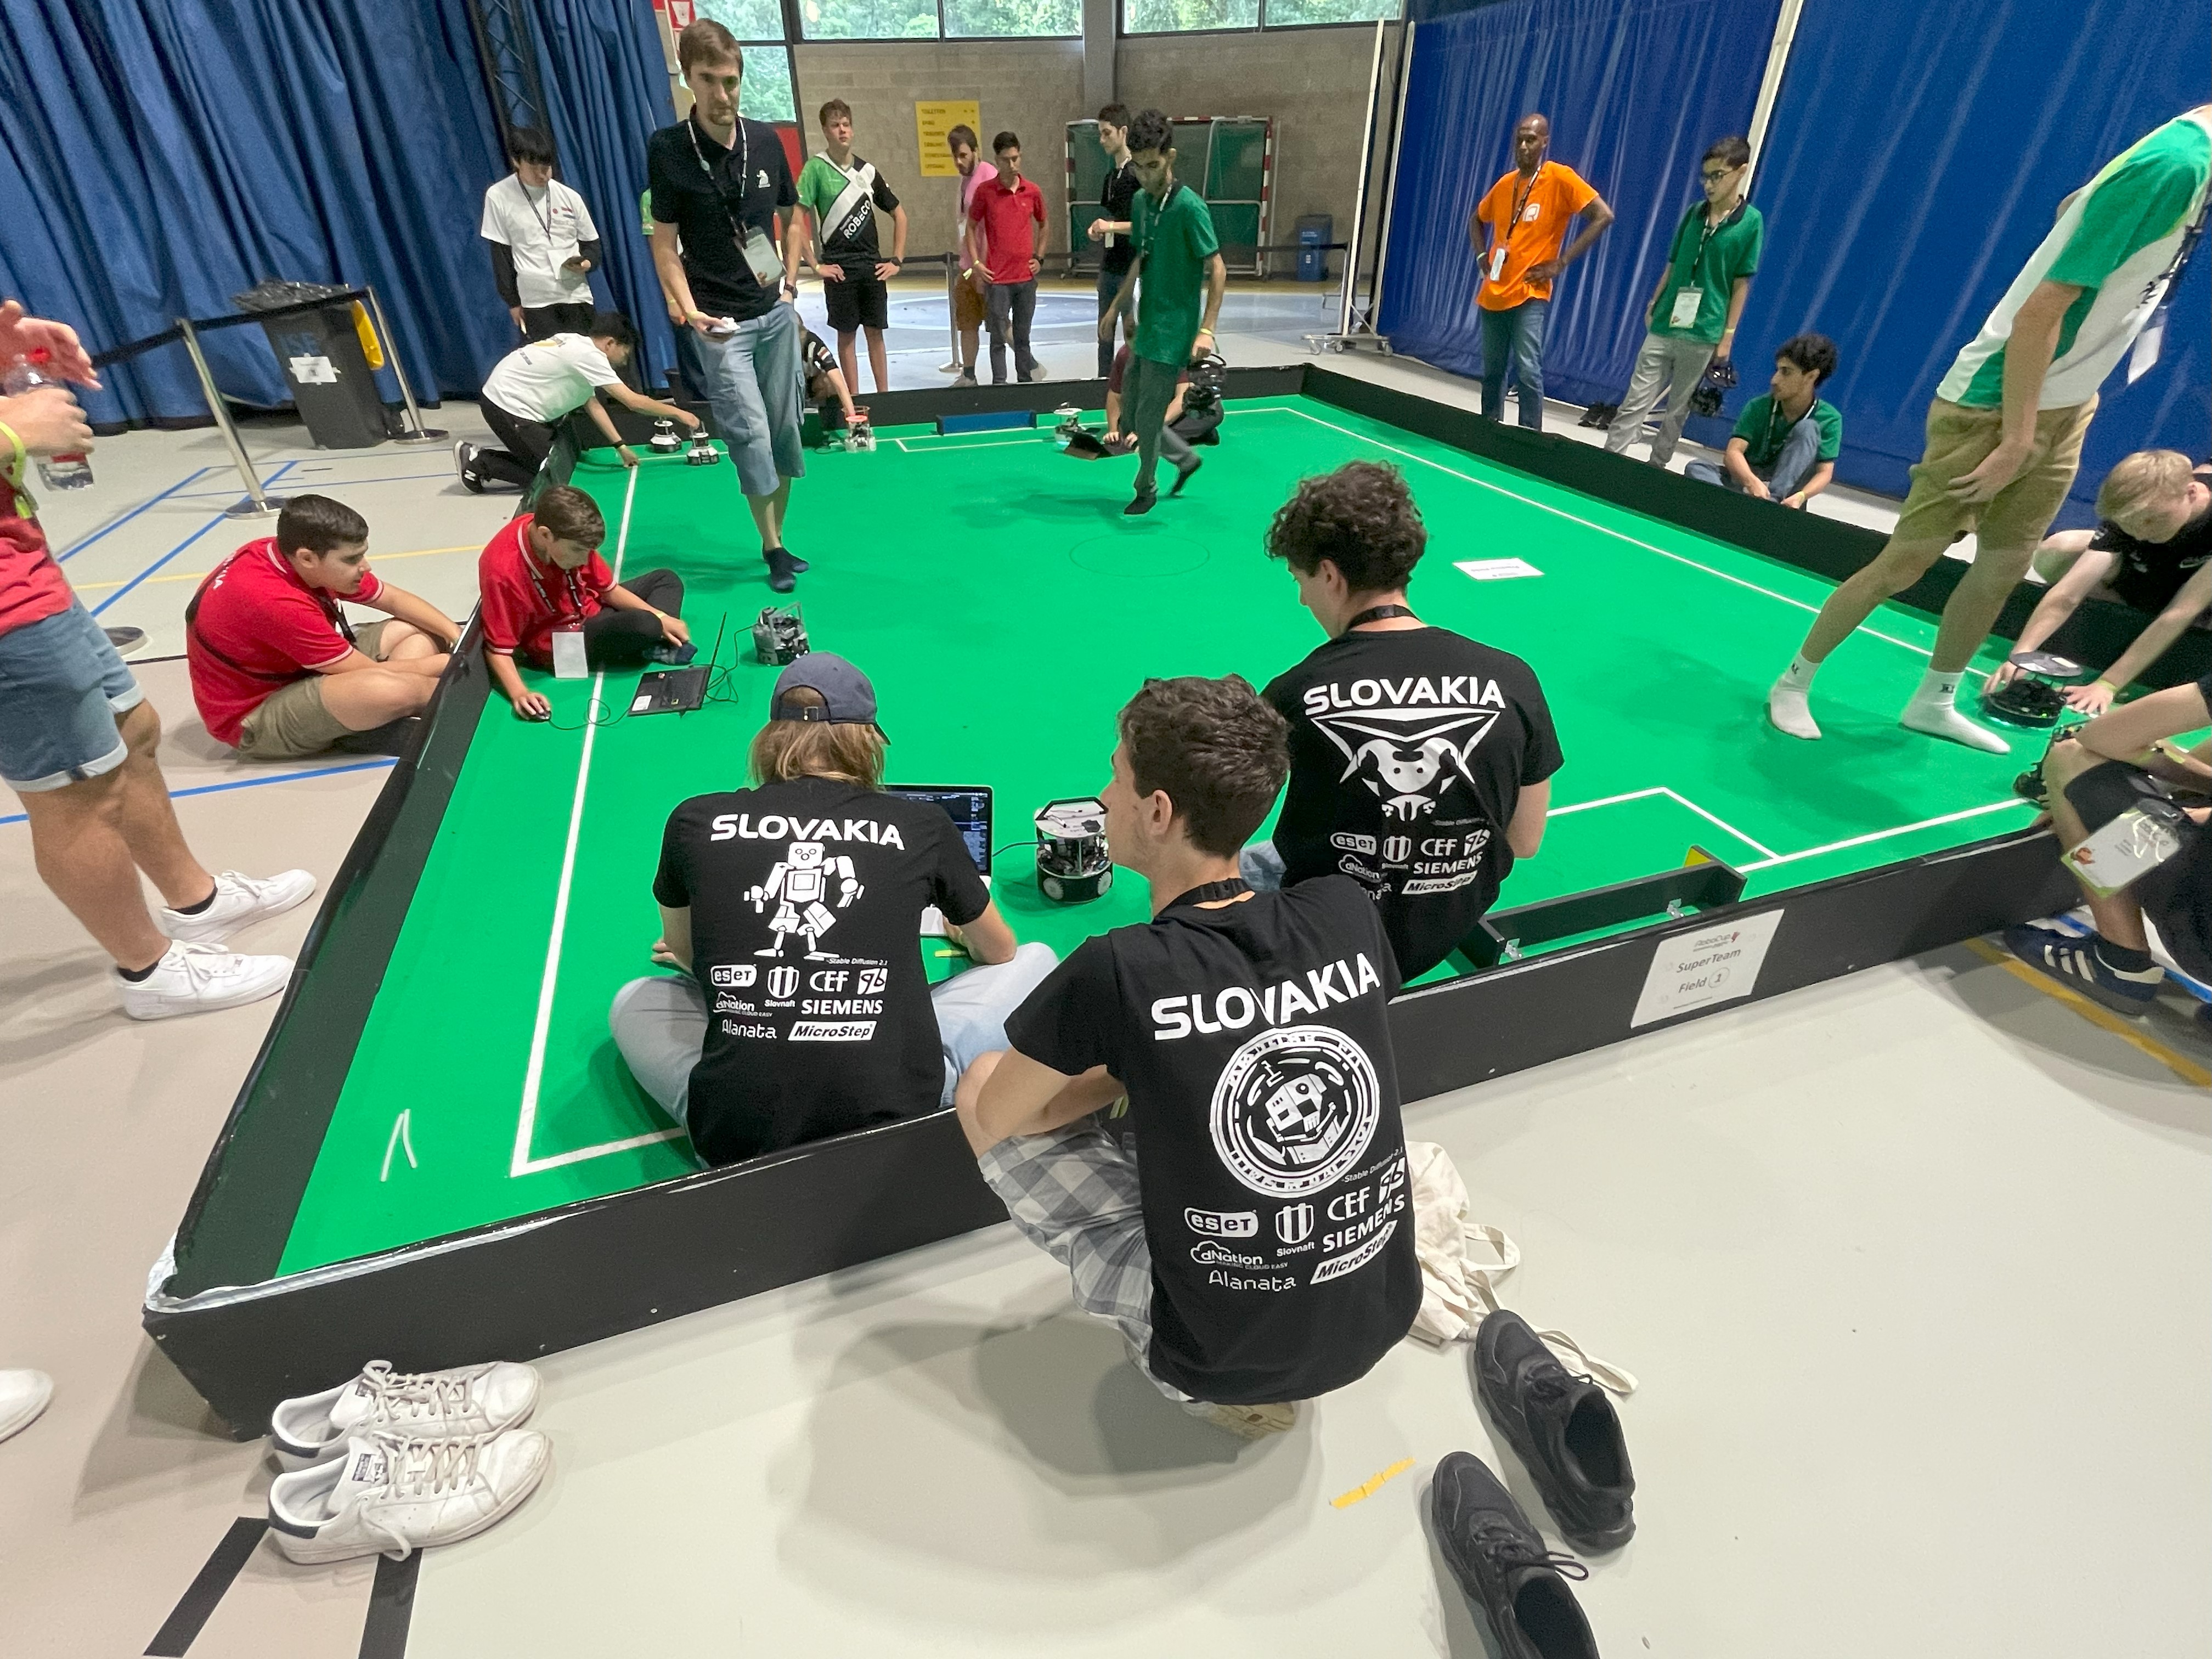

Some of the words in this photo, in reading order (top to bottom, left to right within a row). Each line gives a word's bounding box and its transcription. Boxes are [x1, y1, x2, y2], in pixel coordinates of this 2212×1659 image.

[1303, 676, 1506, 715] SLOVAKIA
[710, 813, 905, 850] SLOVAKIA
[1420, 838, 1458, 856] CEF
[1413, 851, 1483, 874] SIEMENS
[809, 970, 850, 992] CEF
[1678, 977, 1707, 994] Field
[1714, 973, 1722, 983] 1
[764, 999, 796, 1008] Slovnaft
[801, 999, 883, 1015] SIEMENS
[1151, 952, 1381, 1041] SLOVAKIA
[722, 1019, 777, 1039] Alanata
[794, 1025, 871, 1038] MicroStep
[1327, 1186, 1370, 1221] CEF
[1322, 1193, 1406, 1254] SIEMENS
[1201, 1250, 1263, 1265] dNation
[1276, 1241, 1316, 1257] Slovnaft
[1209, 1269, 1297, 1293] Alanata
